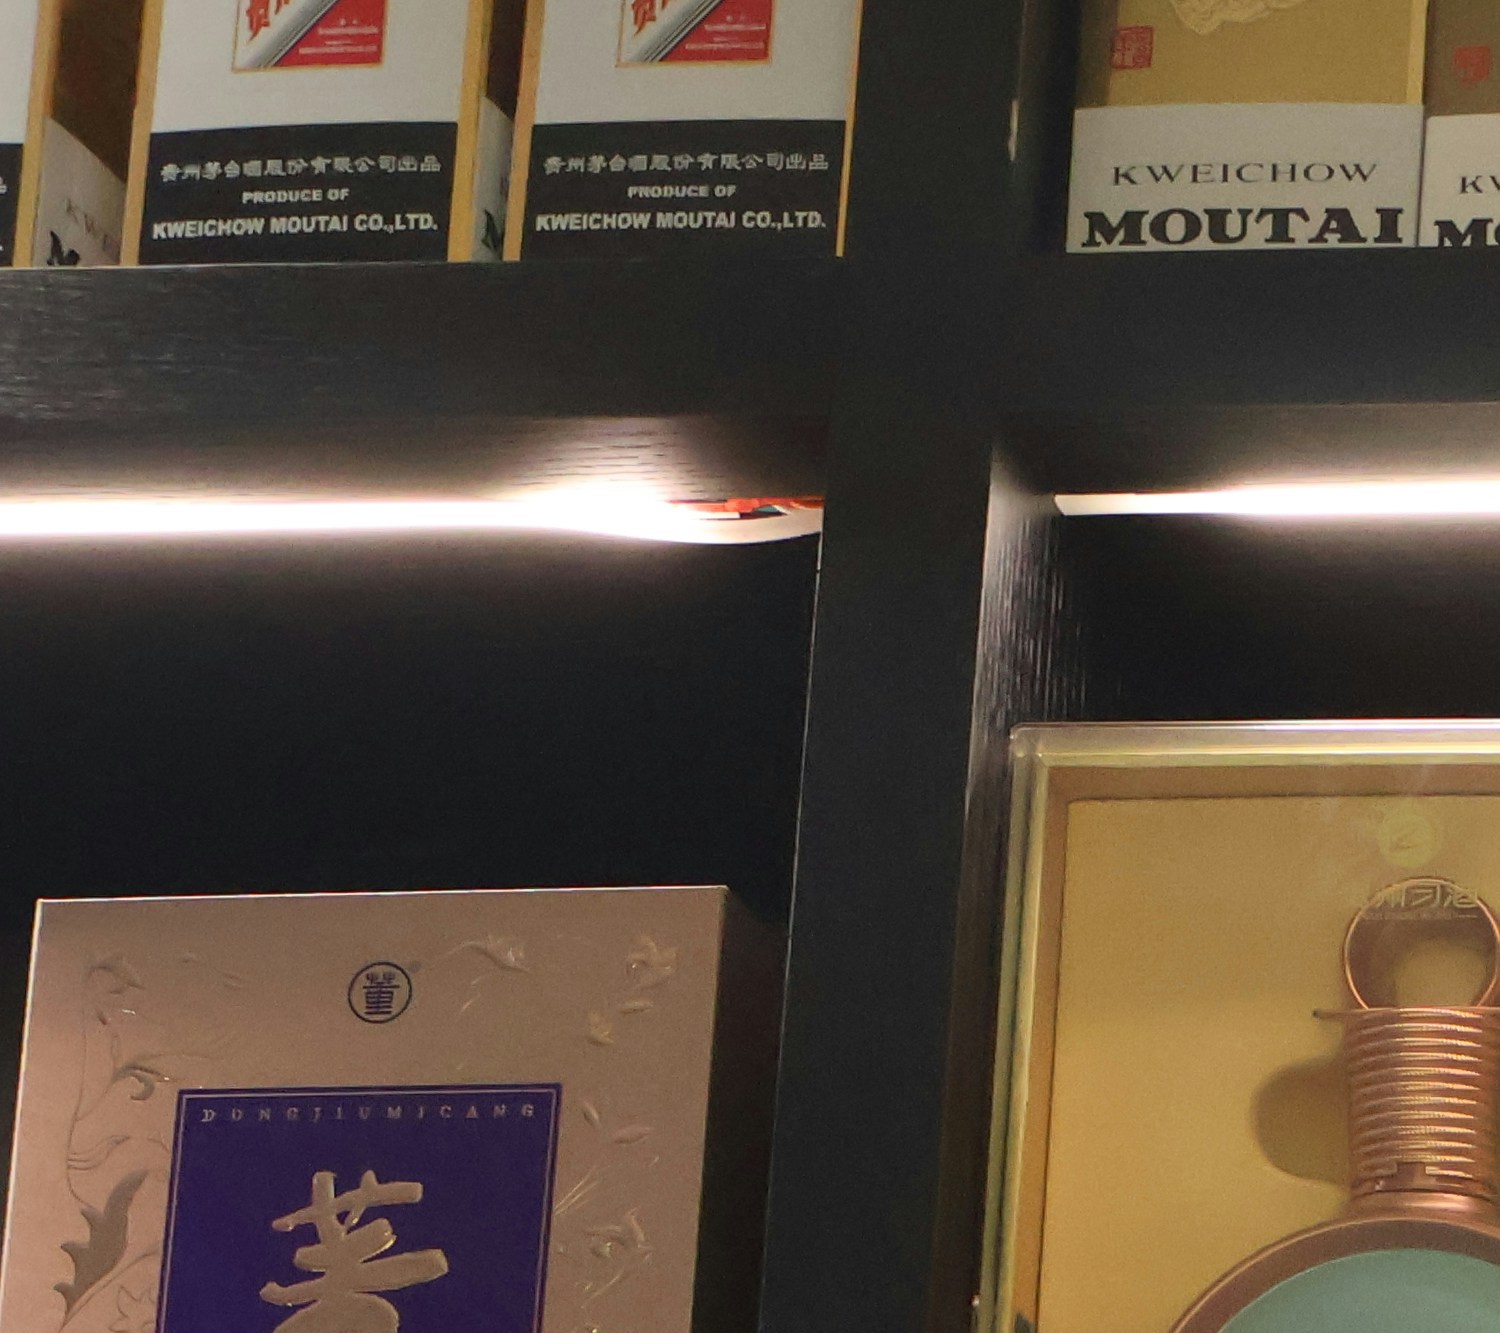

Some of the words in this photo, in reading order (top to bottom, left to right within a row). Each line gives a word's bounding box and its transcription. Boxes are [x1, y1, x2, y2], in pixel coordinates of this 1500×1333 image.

[1113, 163, 1378, 186] KWEICHOW
[242, 188, 323, 204] PRODUCE
[328, 188, 349, 201] OF
[628, 185, 709, 198] PRODUCE
[715, 185, 736, 197] OF
[152, 216, 265, 240] KWEICHOW
[270, 215, 348, 234] MOUTAI
[536, 212, 651, 231] KWEICHOW
[657, 211, 735, 230] MOUTAI
[742, 211, 826, 229] CO.,LTD.
[1081, 207, 1403, 247] MOUTAI
